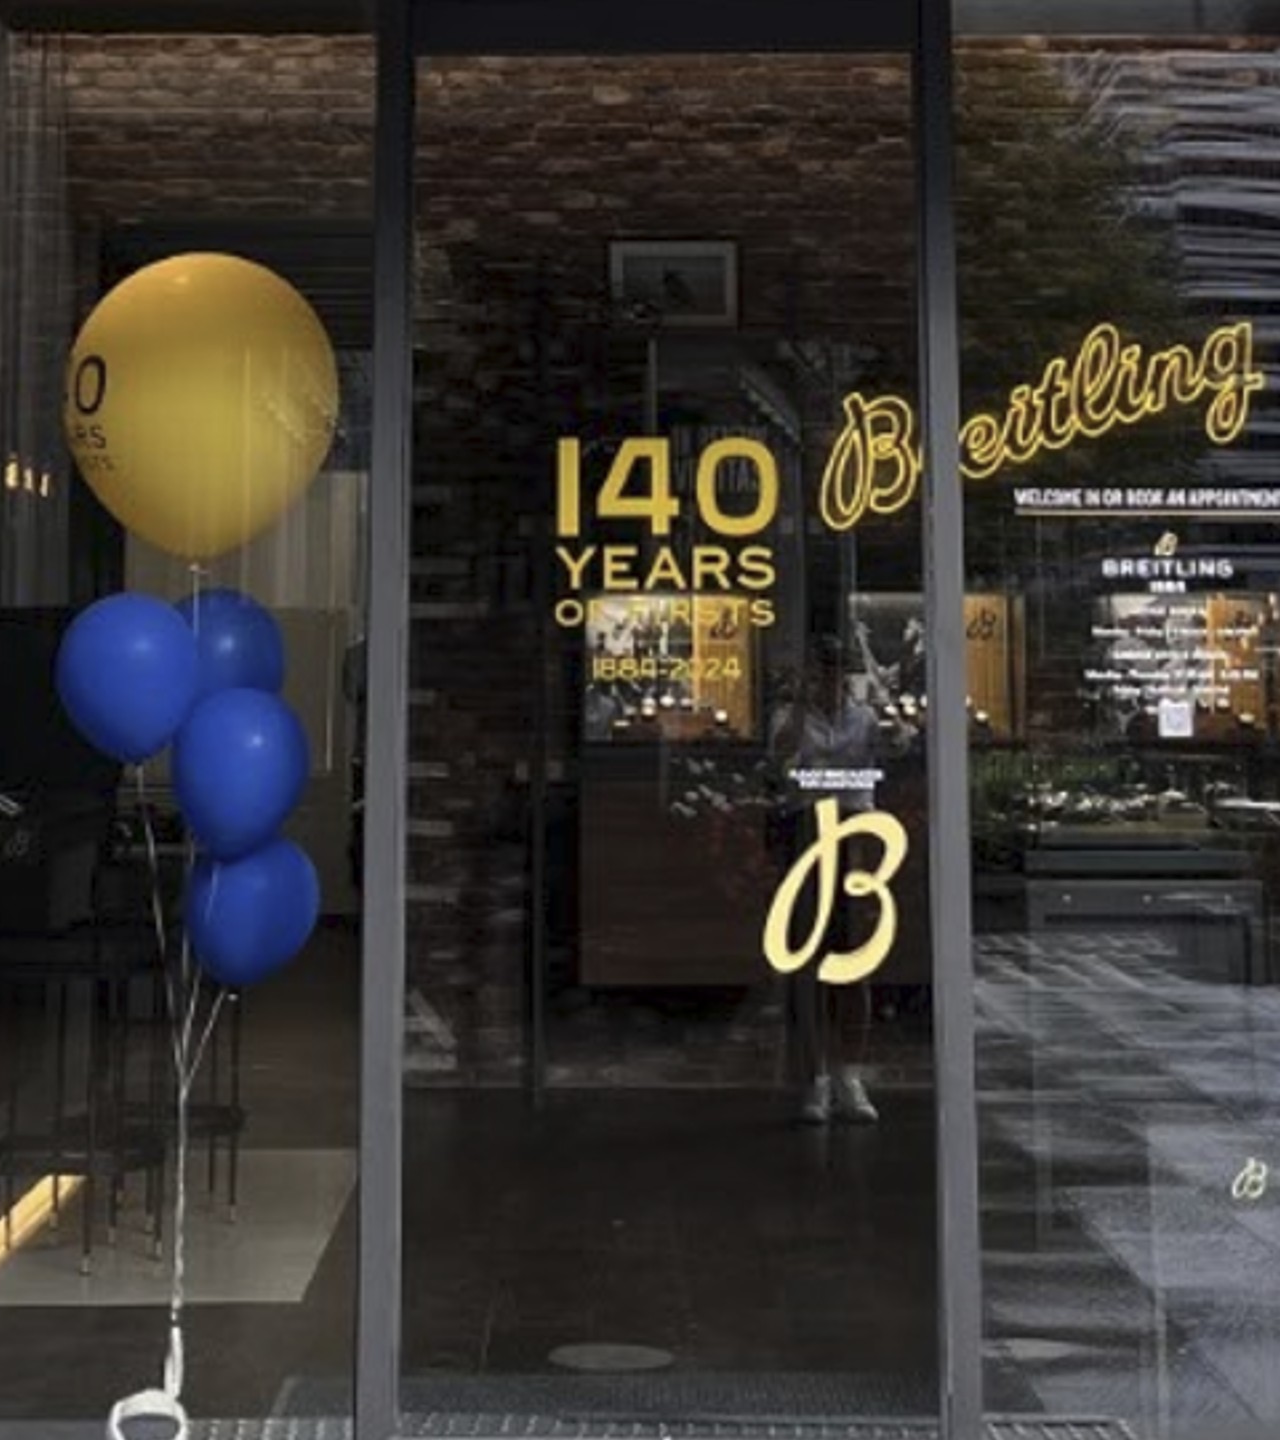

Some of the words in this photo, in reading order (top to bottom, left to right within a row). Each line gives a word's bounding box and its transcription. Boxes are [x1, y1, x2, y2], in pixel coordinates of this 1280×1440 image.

[820, 321, 1265, 531] Beitling
[557, 436, 779, 538] 140
[1014, 488, 1082, 507] WELCOME
[1084, 488, 1101, 507] IN
[1102, 488, 1122, 507] OR
[1126, 488, 1163, 507] BOOK
[1166, 488, 1186, 507] AN
[555, 545, 776, 590] YEARS
[1102, 559, 1234, 578] BREITLING
[555, 599, 604, 627] OF
[627, 599, 776, 627] FIRSTS
[593, 658, 742, 681] 1884-2024
